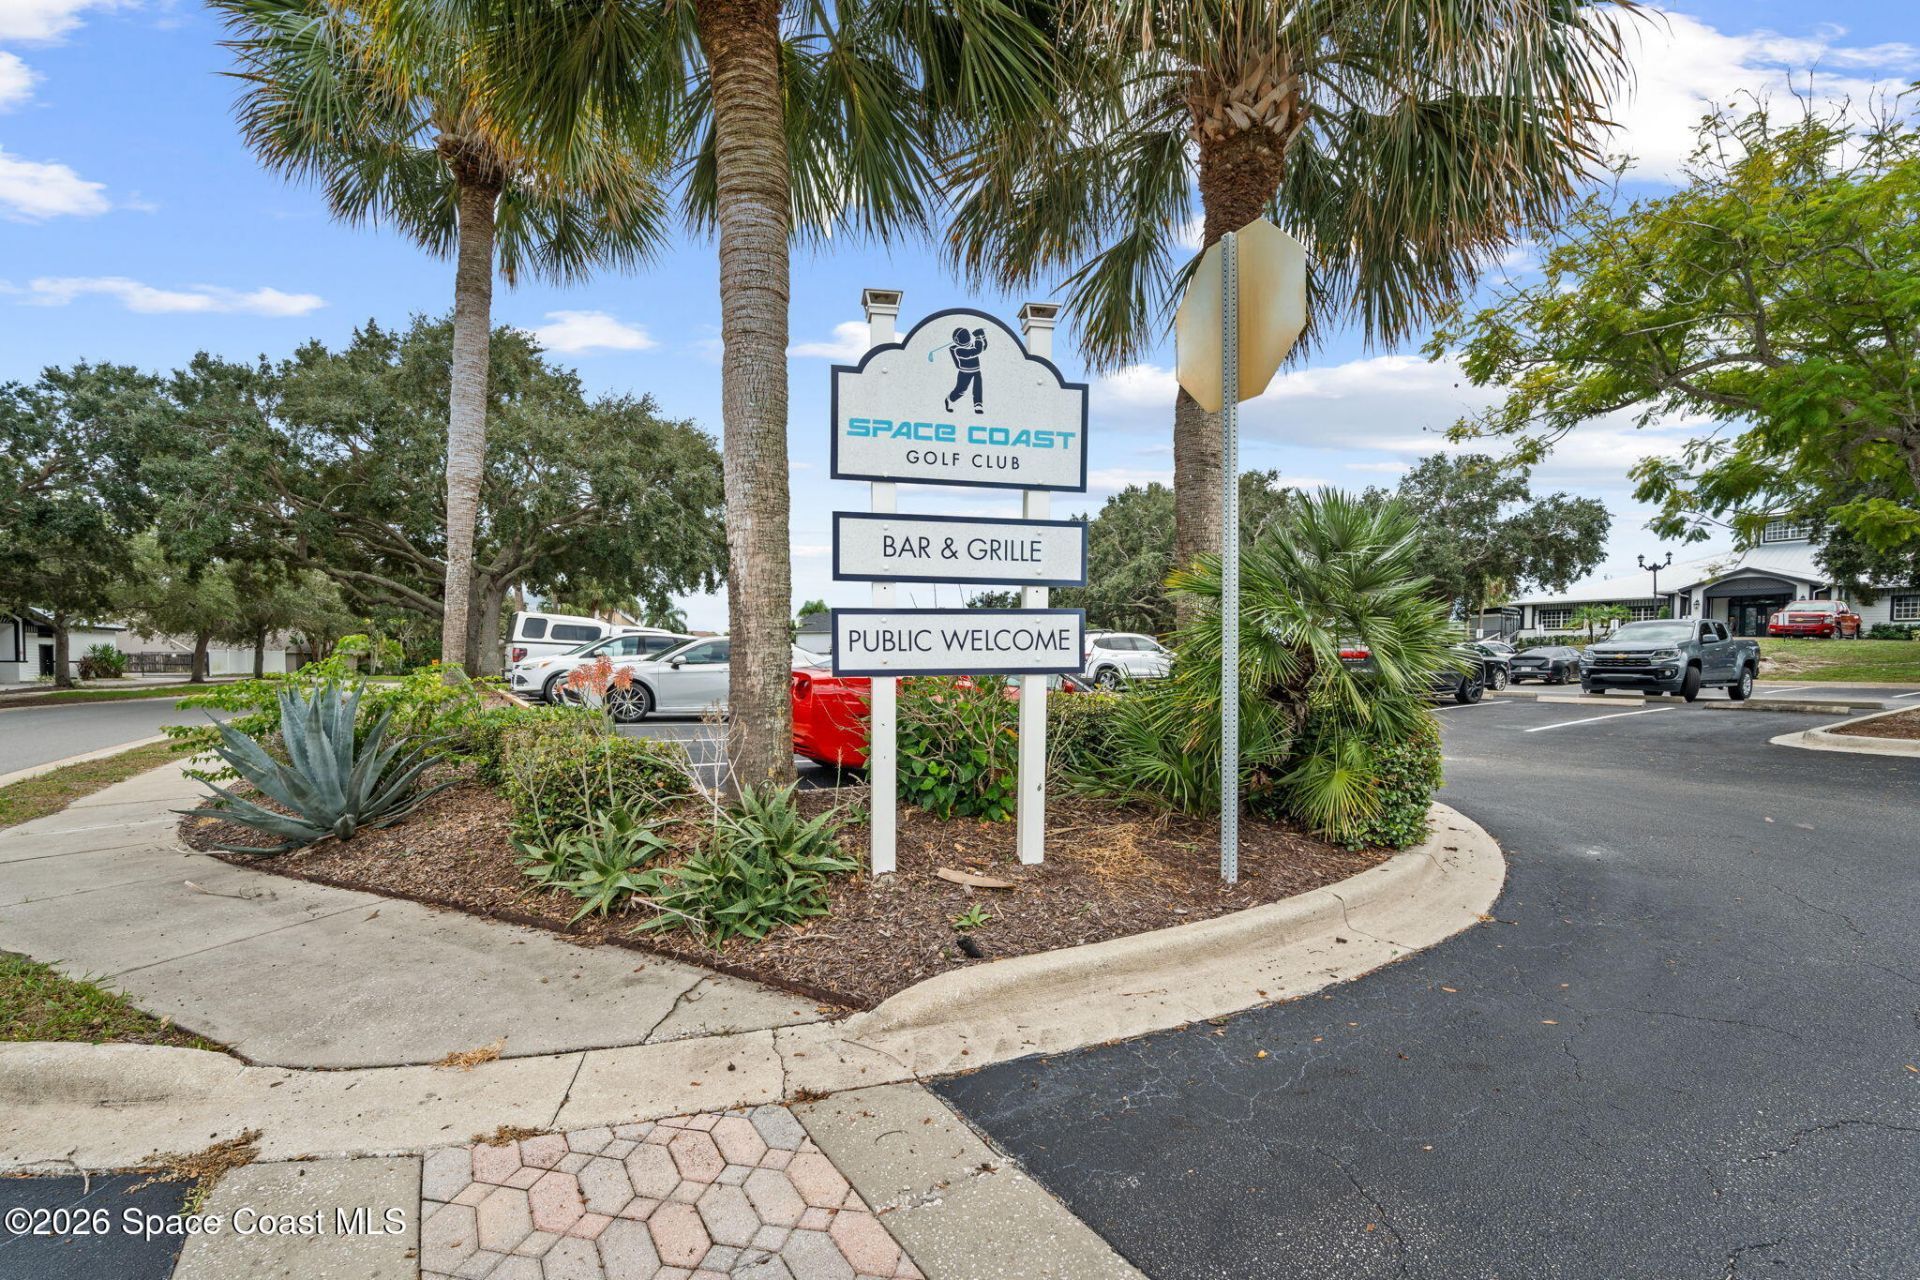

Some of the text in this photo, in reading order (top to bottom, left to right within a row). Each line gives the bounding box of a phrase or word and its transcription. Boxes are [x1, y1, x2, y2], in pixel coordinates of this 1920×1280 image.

[846, 417, 1077, 450] SPACE COAST
[906, 449, 1020, 471] GOLF CLUB
[882, 534, 1043, 563] BAR & GRILLE
[848, 628, 1071, 653] PUBLIC WELCOME
